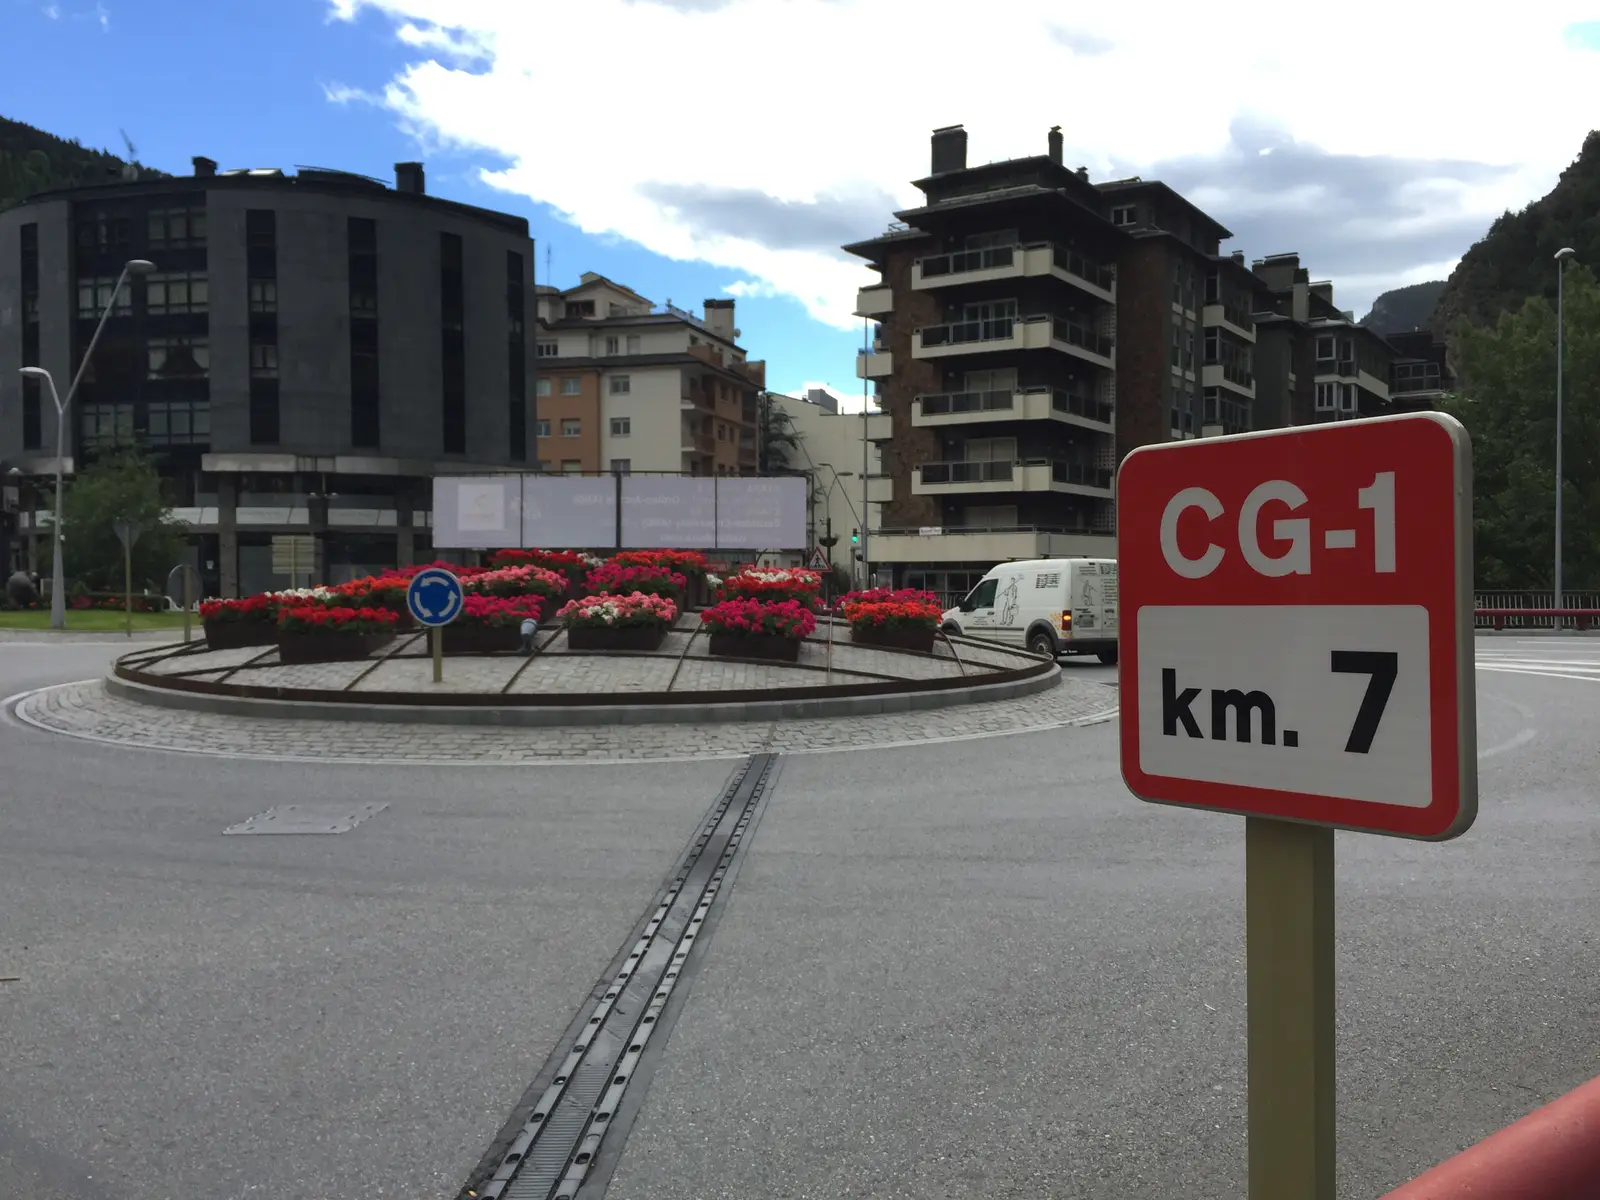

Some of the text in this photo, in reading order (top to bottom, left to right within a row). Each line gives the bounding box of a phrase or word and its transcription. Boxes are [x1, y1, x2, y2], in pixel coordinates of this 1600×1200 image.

[1159, 471, 1396, 579] CG-1
[1161, 650, 1398, 754] km. 7
